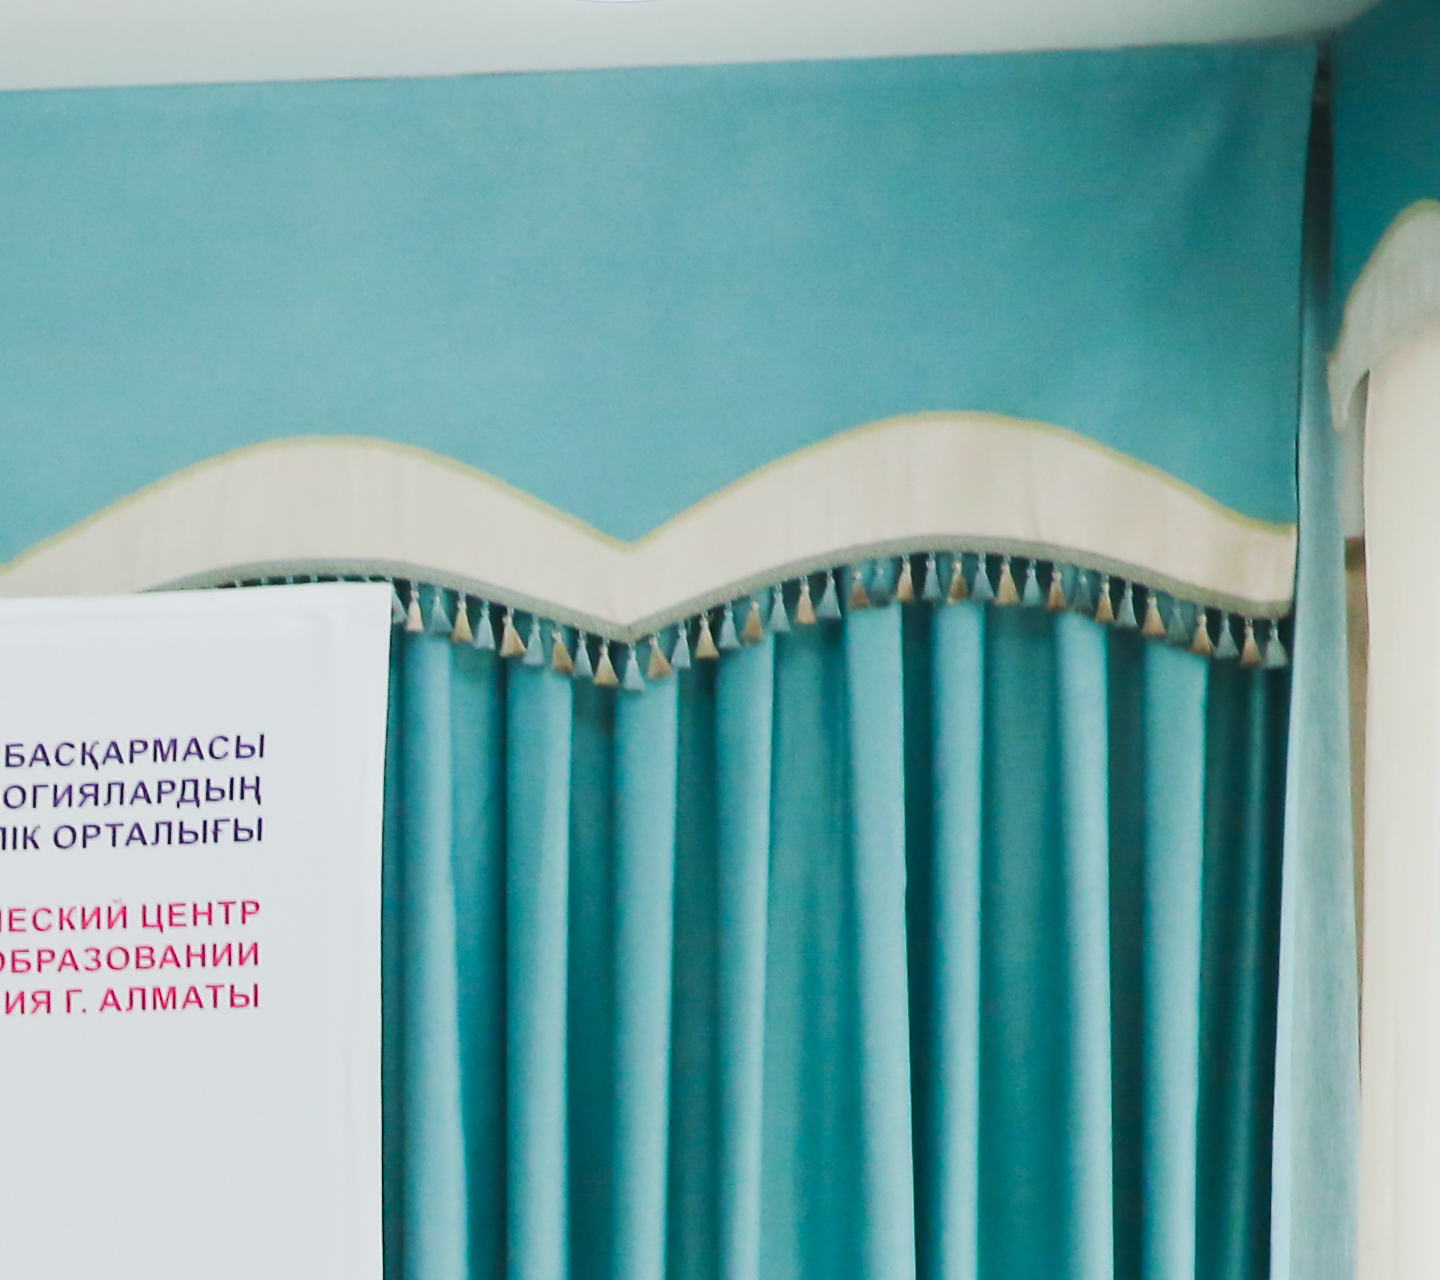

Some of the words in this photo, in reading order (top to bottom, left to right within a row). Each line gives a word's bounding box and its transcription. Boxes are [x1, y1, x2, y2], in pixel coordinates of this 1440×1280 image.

[5, 733, 264, 771] БАСҚАРМАСЫ
[53, 817, 262, 849] ОРТАЛЫҒЫ
[142, 900, 260, 933] ЦЕНТР
[66, 989, 86, 1013] Г.
[99, 983, 258, 1012] АЛМАТЫ
